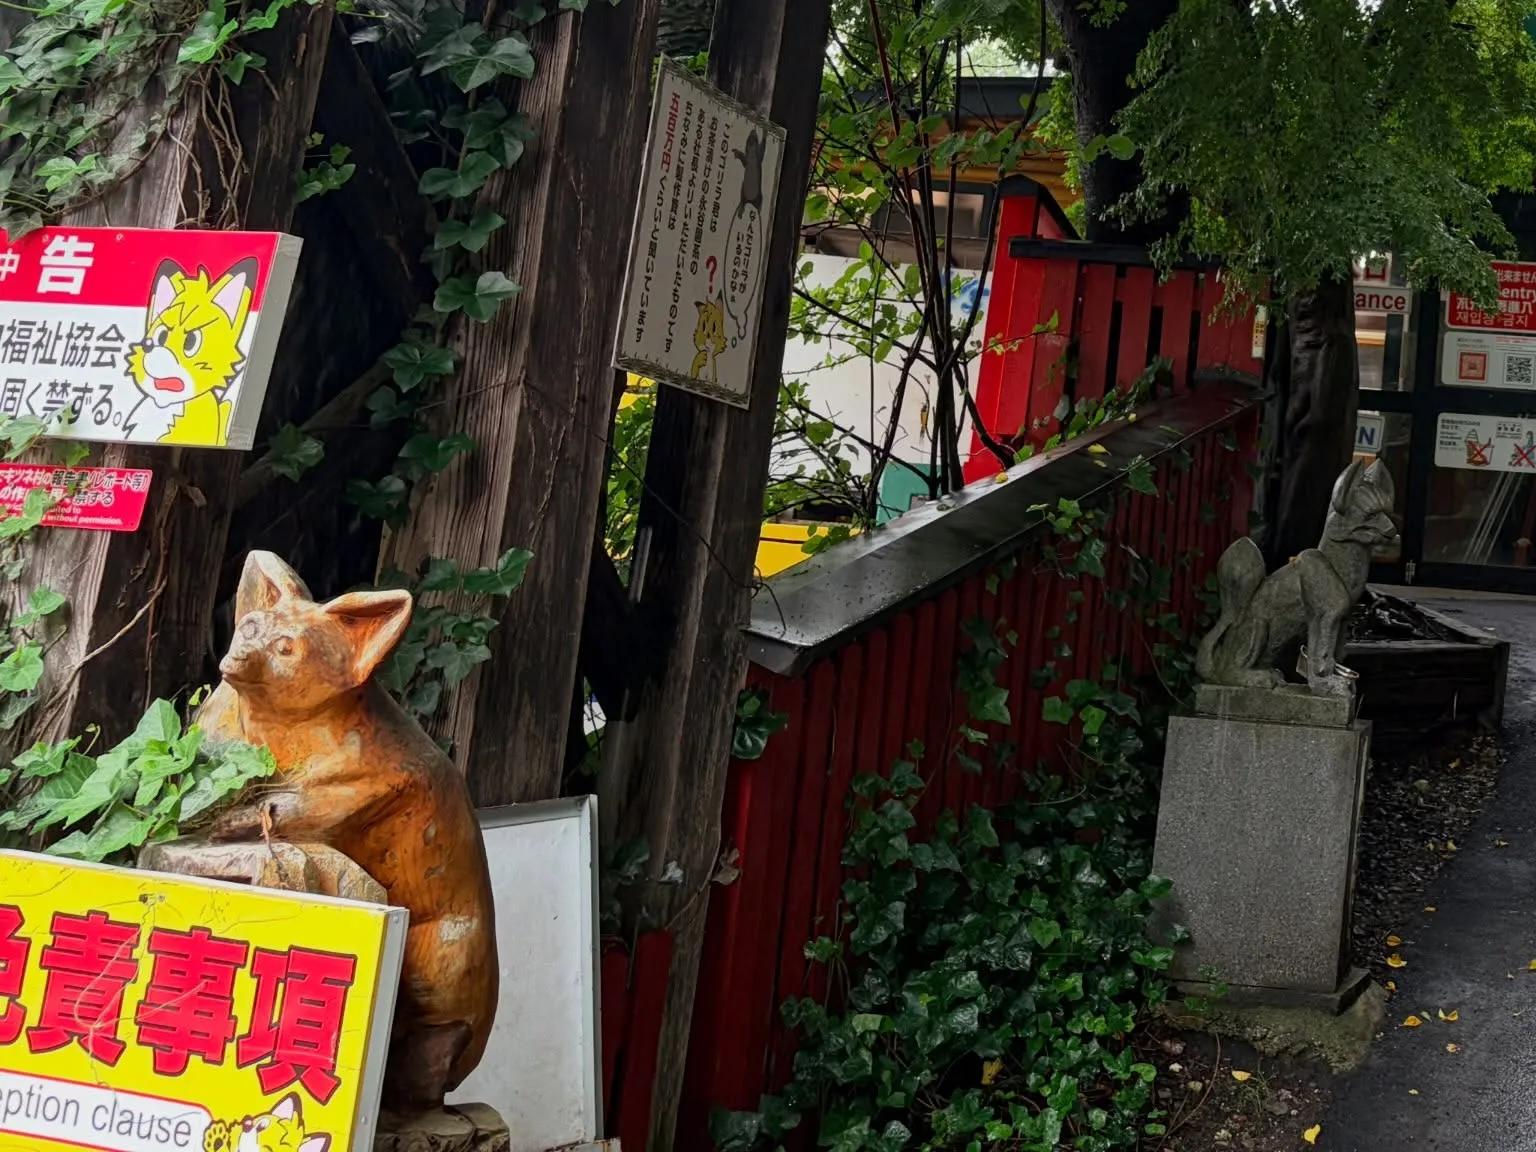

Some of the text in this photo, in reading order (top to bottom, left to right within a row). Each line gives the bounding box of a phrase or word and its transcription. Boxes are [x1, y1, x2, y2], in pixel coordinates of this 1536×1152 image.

[709, 123, 731, 233] このゴリラ君は
[36, 234, 96, 296] 告
[1354, 292, 1407, 310] ance
[1503, 313, 1529, 328] 금지
[0, 319, 126, 369] 福祉協会
[0, 1083, 192, 1148] ption clause
